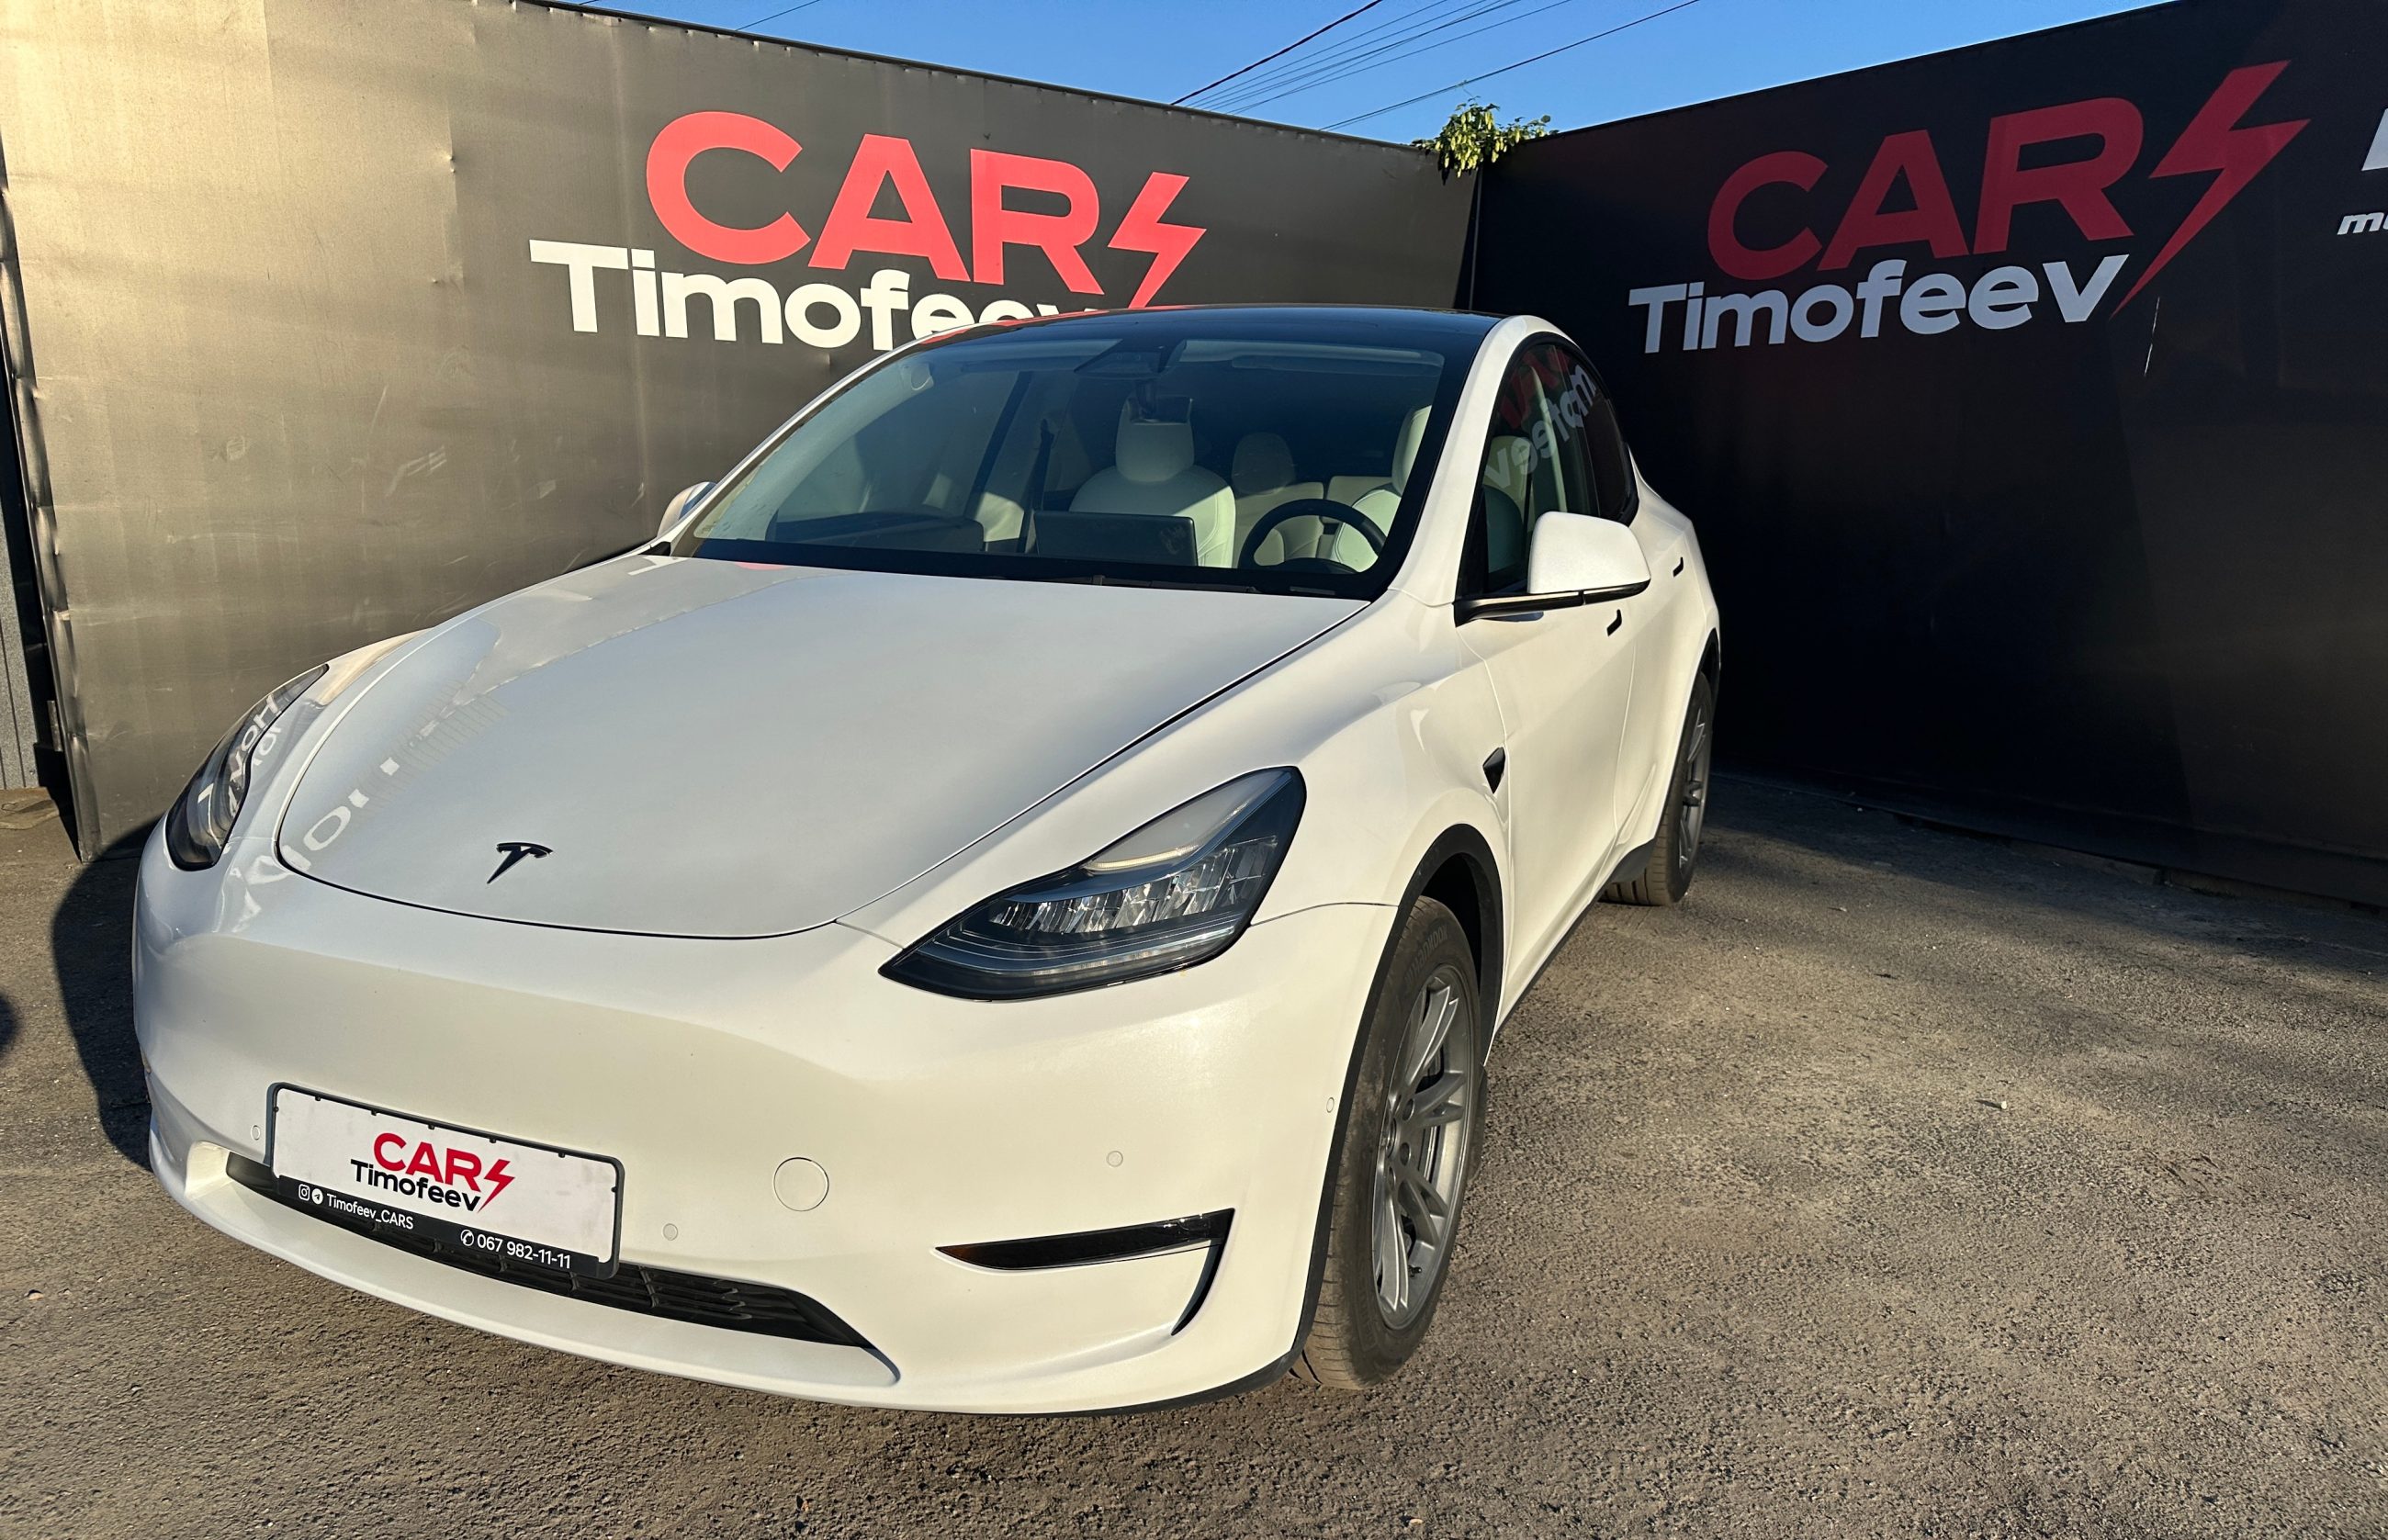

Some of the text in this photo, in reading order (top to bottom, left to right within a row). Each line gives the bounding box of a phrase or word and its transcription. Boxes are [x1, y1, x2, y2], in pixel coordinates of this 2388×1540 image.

[528, 239, 1098, 351] Timofe
[1628, 253, 2129, 354] Timofeev
[326, 1193, 414, 1231] Timofeev_CARS
[350, 1158, 481, 1212] Timofeev
[477, 1233, 571, 1269] 067 982-11-11
